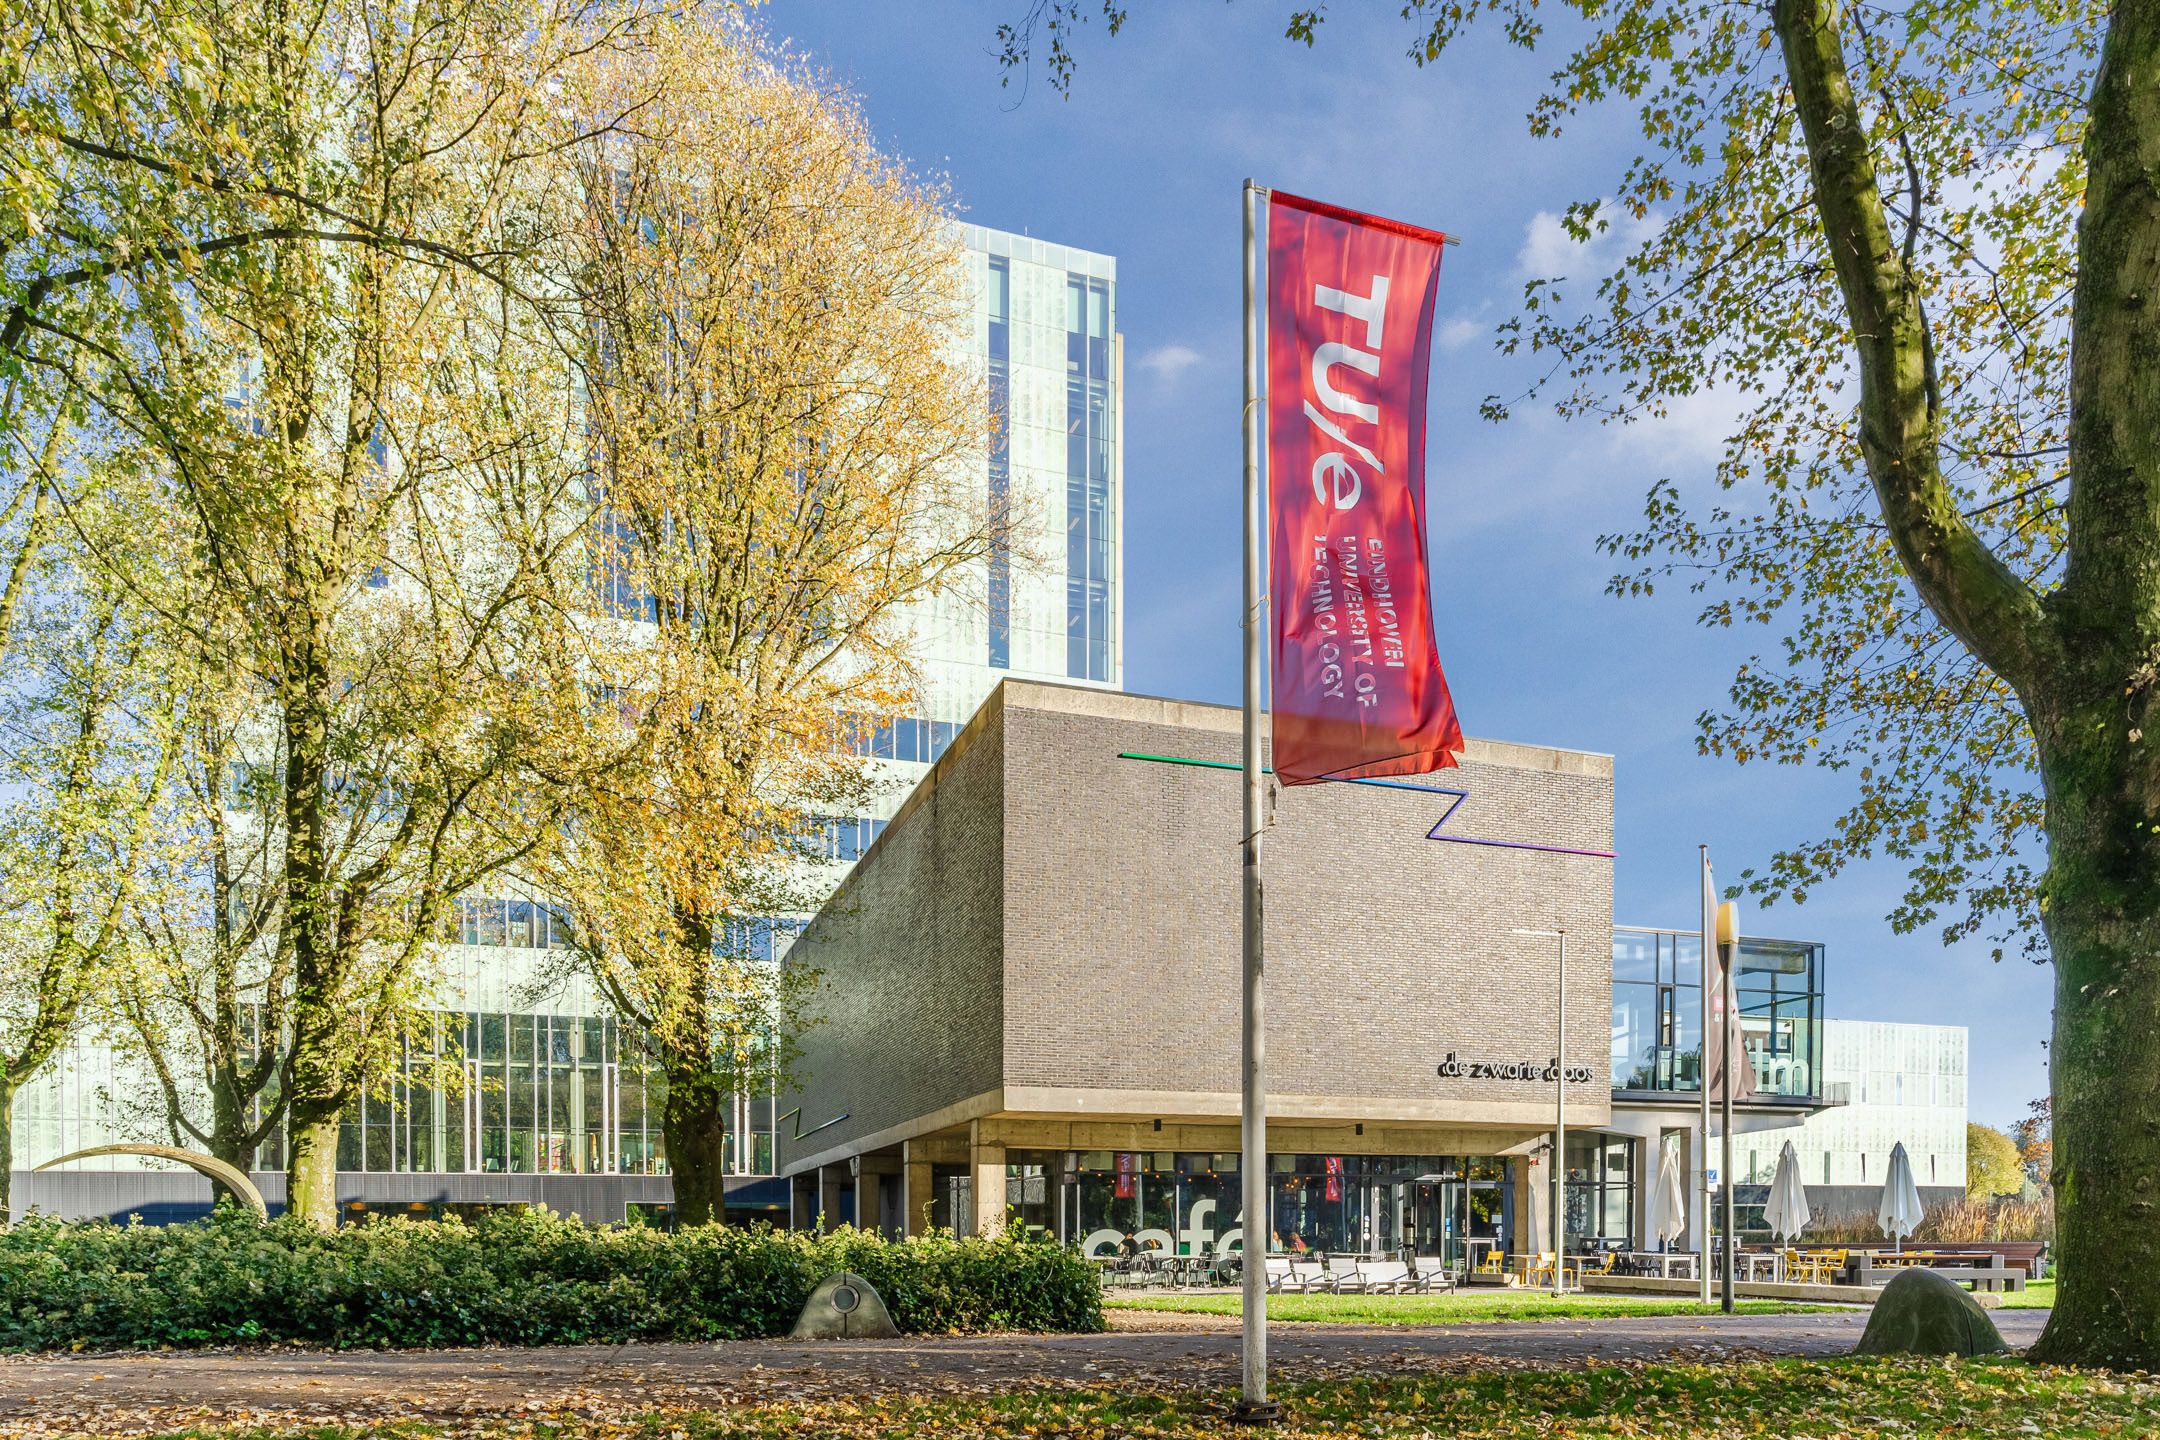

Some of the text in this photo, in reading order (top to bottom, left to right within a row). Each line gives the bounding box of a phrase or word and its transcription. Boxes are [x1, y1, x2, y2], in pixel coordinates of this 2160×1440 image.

[1303, 274, 1390, 510] TU/e
[1310, 534, 1344, 699] TECHNOLOGY
[1336, 535, 1378, 707] UNIVERSITY OF
[1367, 537, 1405, 668] EINDHOVEN
[1438, 1051, 1593, 1083] de zwarte doos
